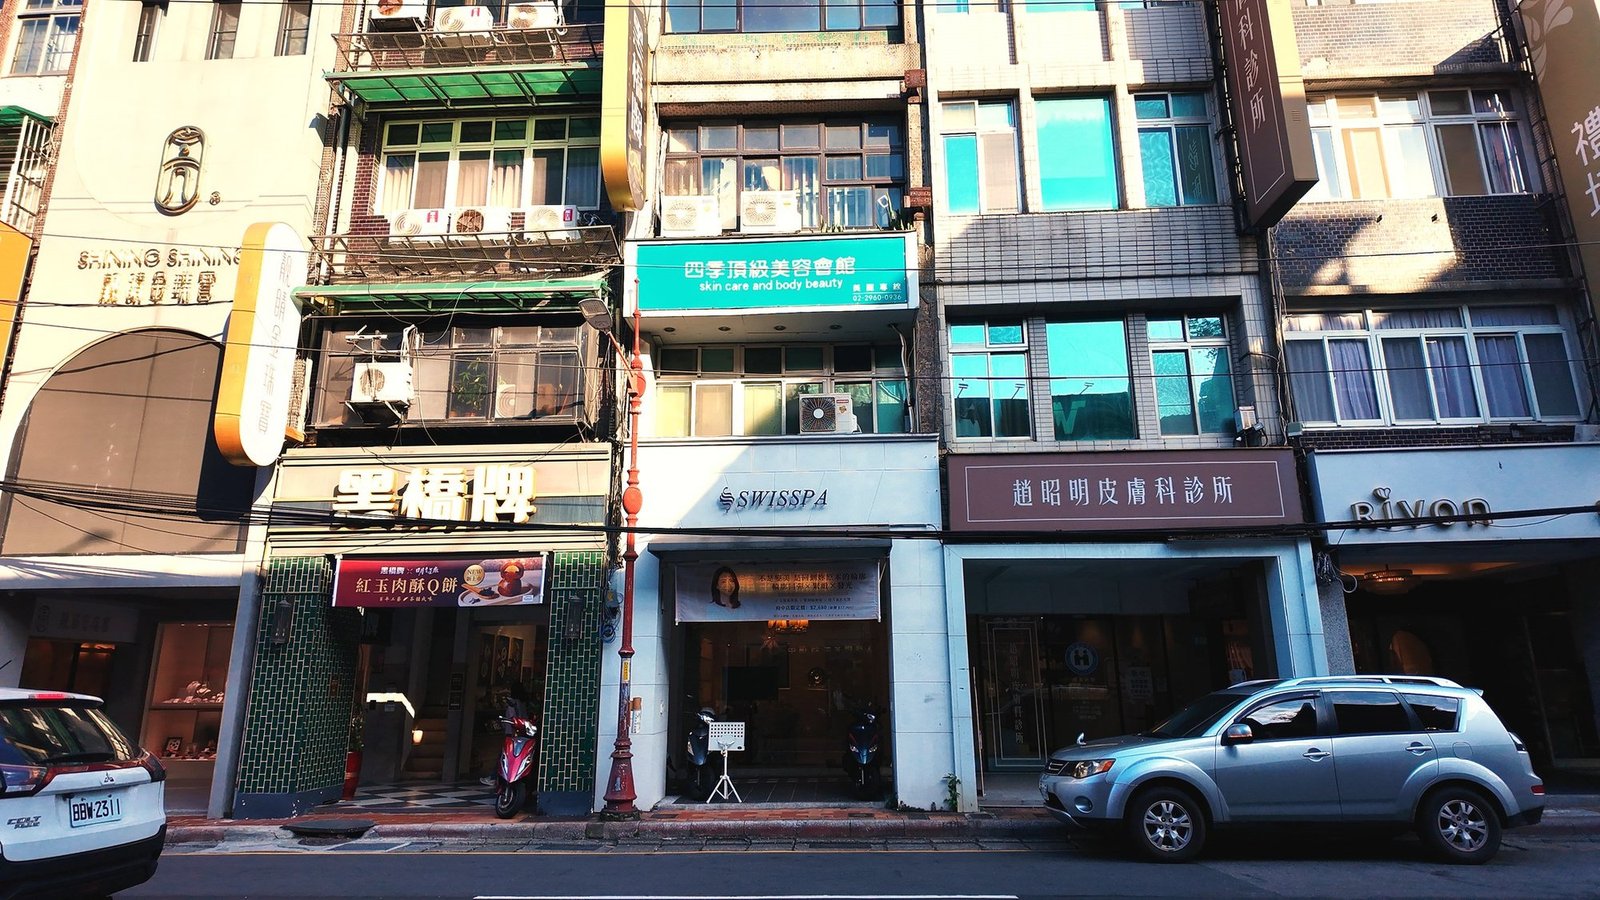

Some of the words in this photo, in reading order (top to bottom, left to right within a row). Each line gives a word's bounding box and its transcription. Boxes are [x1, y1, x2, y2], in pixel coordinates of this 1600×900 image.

[77, 248, 161, 269] SHINING
[684, 256, 856, 280] 四季頂級美容會館
[699, 281, 723, 292] skin
[724, 282, 750, 291] care
[752, 280, 773, 291] and
[775, 279, 803, 291] body
[805, 277, 843, 291] beauty
[852, 294, 902, 302] 02-2960-0936
[332, 464, 538, 526] 黑橋牌
[737, 488, 828, 508] SWISSPA
[1012, 475, 1235, 507] 趙昭明皮膚科診所
[355, 576, 459, 596] 紅玉肉酥Q餅
